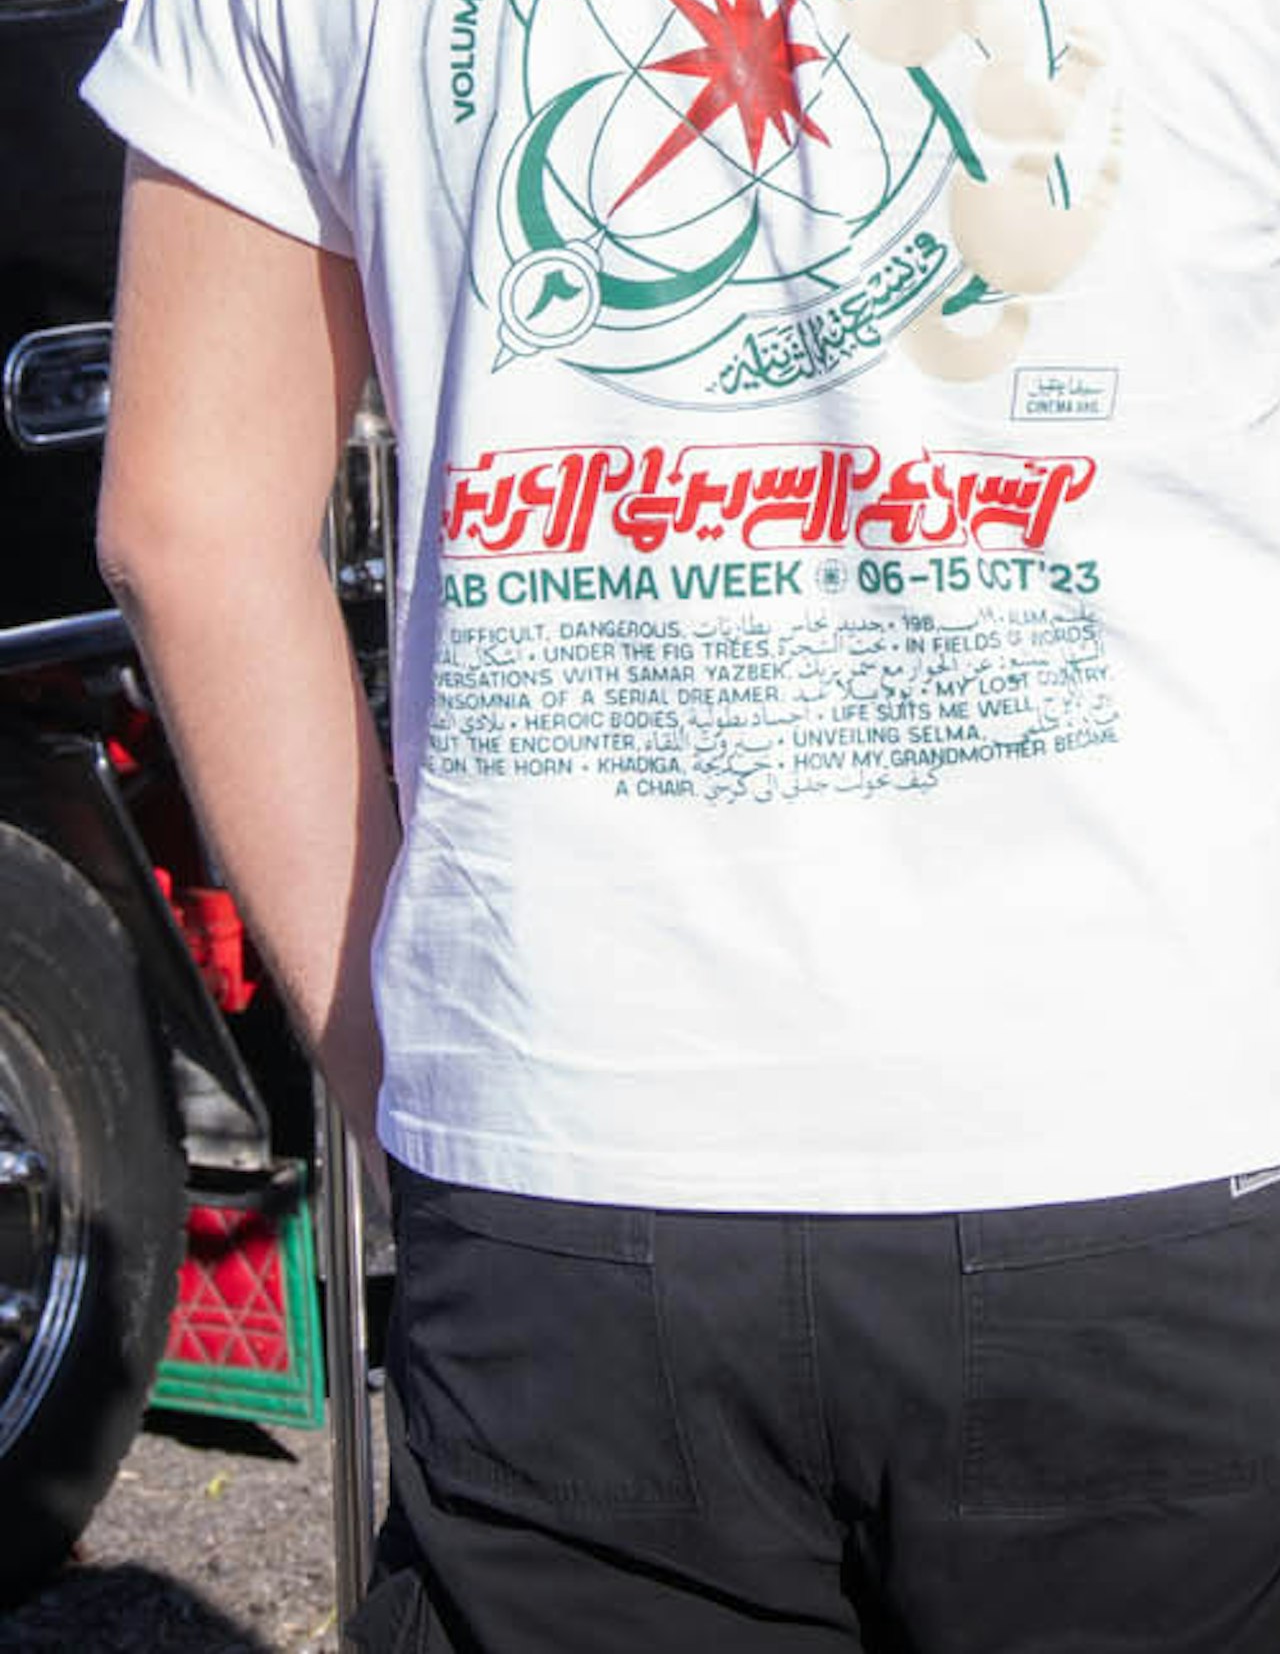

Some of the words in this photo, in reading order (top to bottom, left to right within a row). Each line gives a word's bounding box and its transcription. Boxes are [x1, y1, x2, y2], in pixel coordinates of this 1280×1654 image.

[498, 565, 658, 606] CINEMA
[672, 560, 803, 600] WEEK
[544, 644, 615, 662] UNDER
[622, 643, 656, 661] THE
[664, 642, 694, 660] FIG
[906, 636, 925, 653] IN
[934, 632, 1001, 653] FIELDS
[563, 666, 619, 684] WITH
[628, 665, 694, 683] SAMAR
[936, 678, 968, 696] MY
[979, 673, 1028, 693] LOST
[542, 691, 567, 708] OF
[582, 689, 594, 704] A
[605, 688, 669, 706] SERIAL
[526, 711, 604, 730] HEROIC
[832, 704, 869, 722] LIFE
[876, 701, 931, 721] SUITS
[939, 701, 968, 719] ME
[467, 736, 500, 754] THE
[793, 726, 900, 747] UNVEILING
[795, 752, 845, 769] HOW
[853, 750, 881, 767] MY
[890, 739, 1046, 767] GRANDMOTHER
[443, 757, 466, 774] ON
[475, 757, 506, 775] THE
[515, 757, 572, 776] HORN
[615, 780, 628, 796] A
